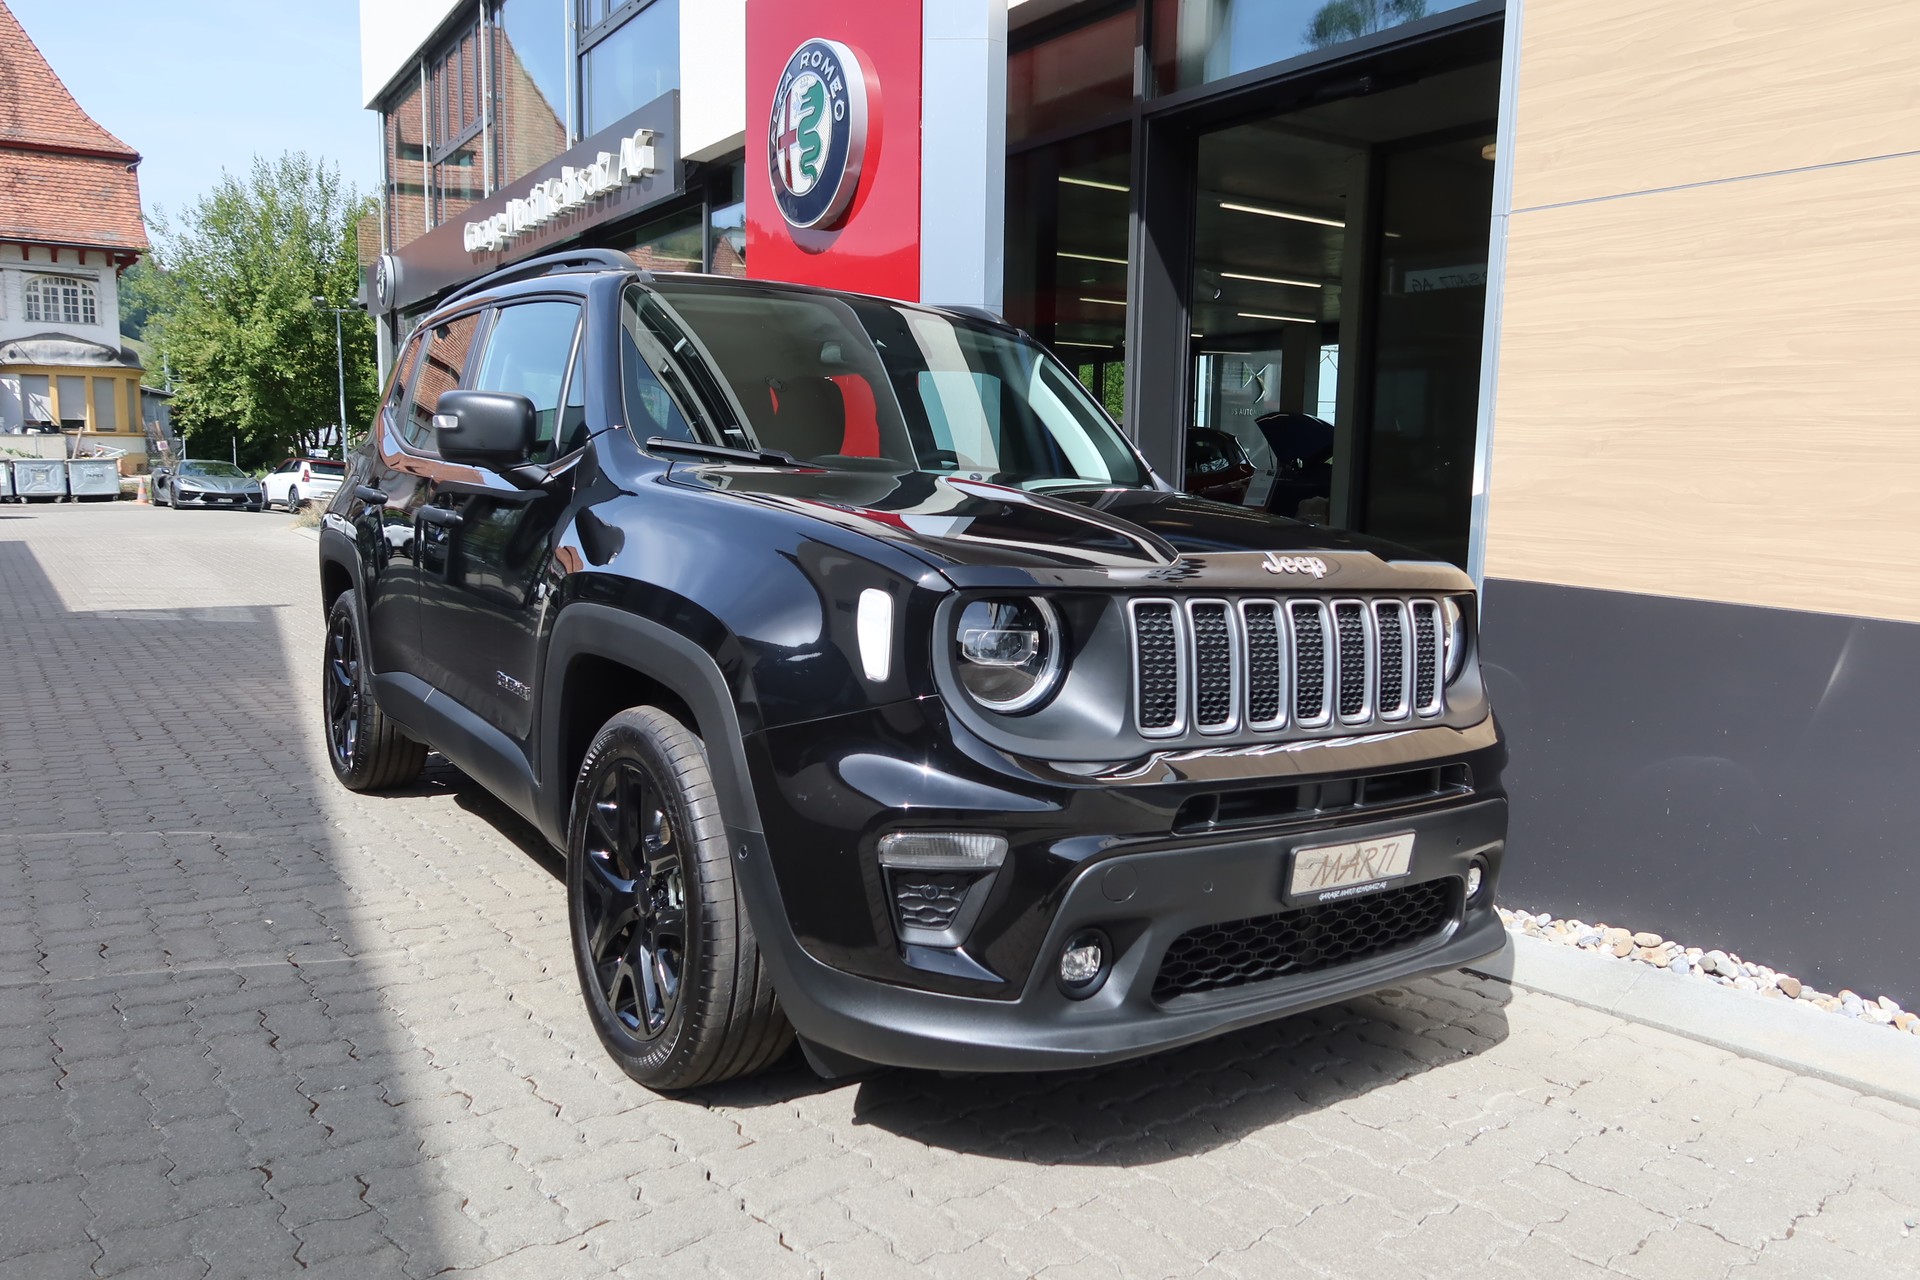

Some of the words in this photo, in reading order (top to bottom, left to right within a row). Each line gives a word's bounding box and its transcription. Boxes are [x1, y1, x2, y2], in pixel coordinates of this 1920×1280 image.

[770, 71, 794, 147] ALFA
[799, 50, 845, 122] ROMEO
[619, 128, 655, 182] AG
[1262, 551, 1327, 579] Jeep
[1309, 842, 1400, 887] MARTI
